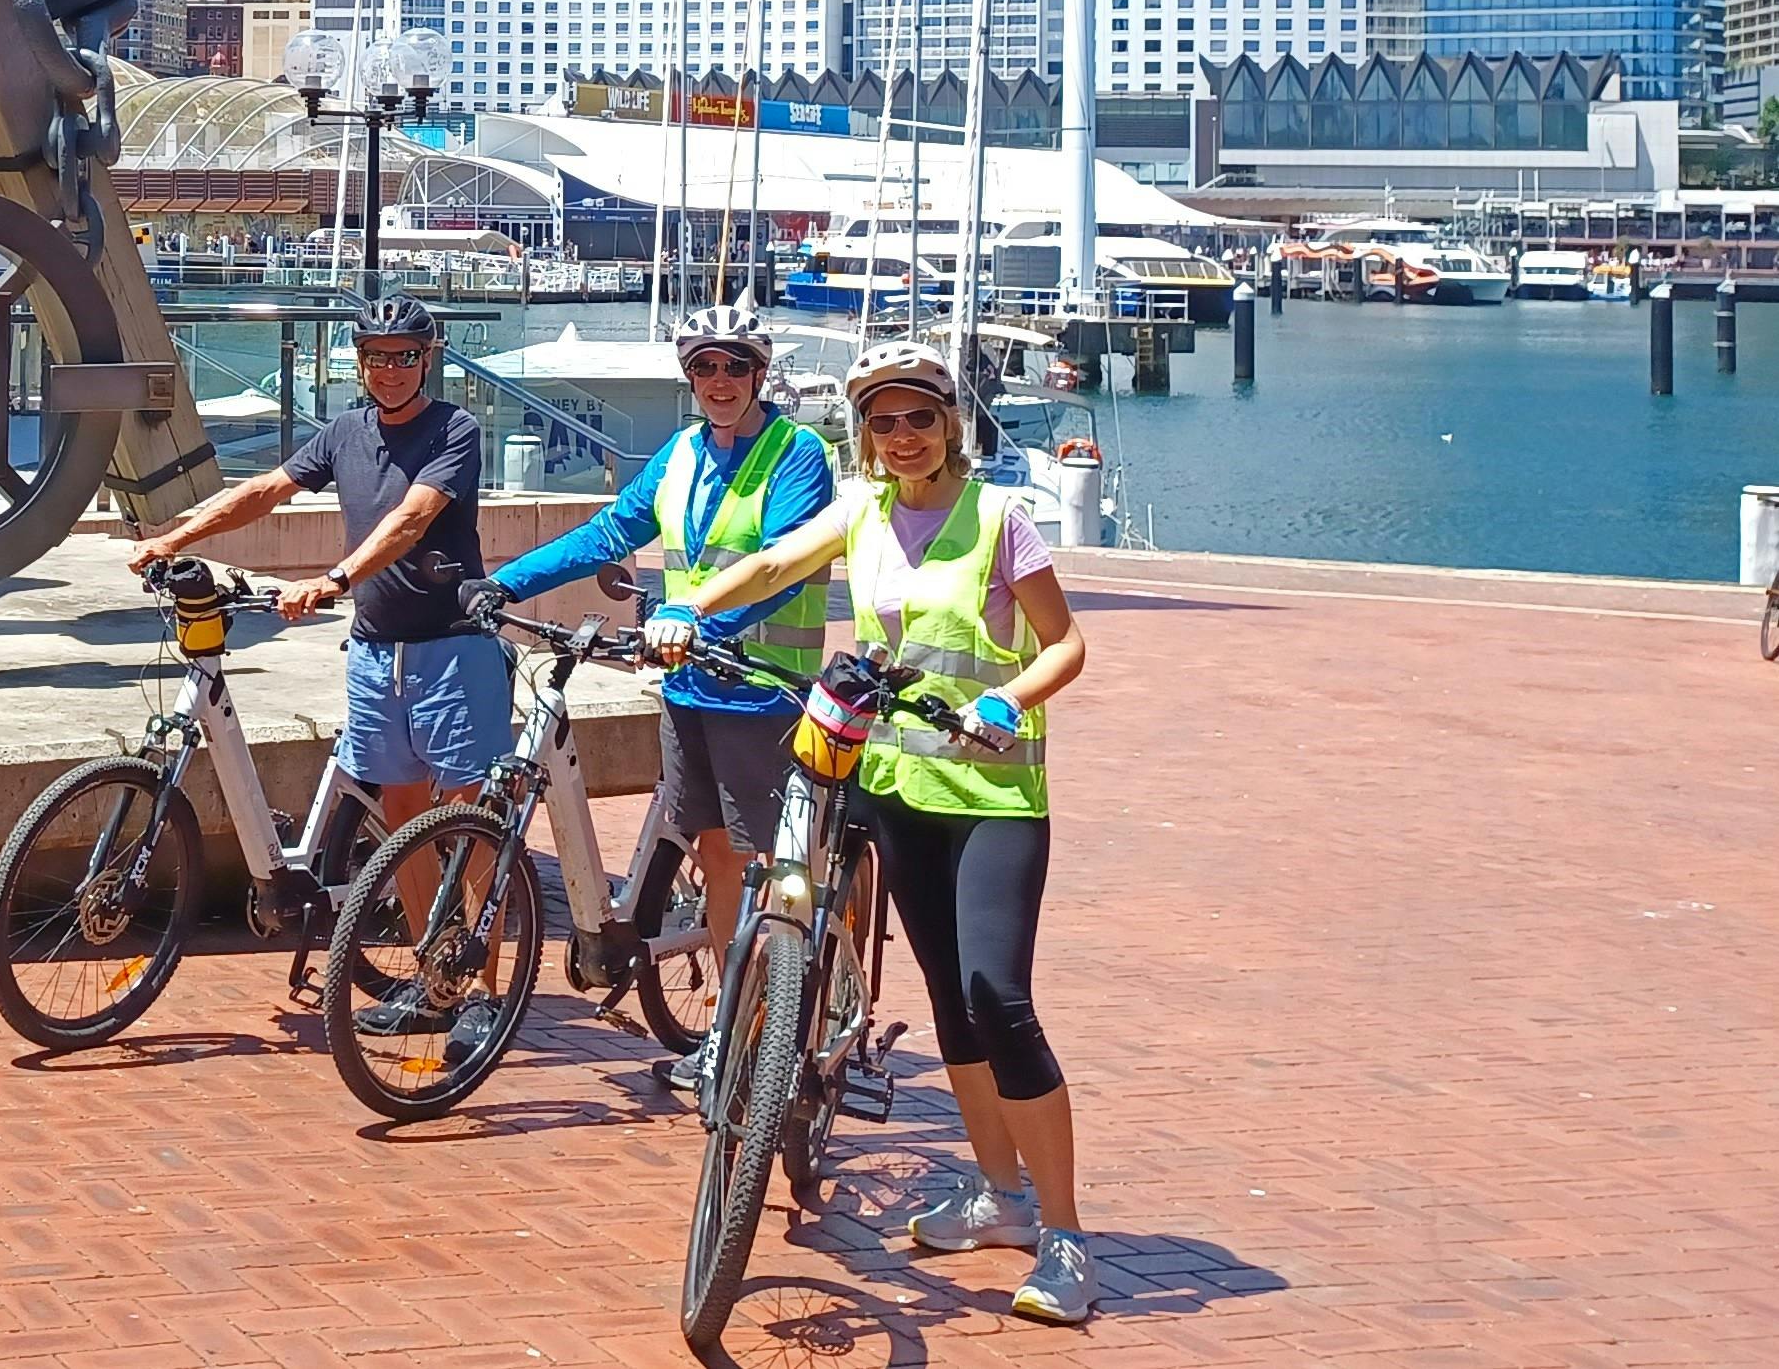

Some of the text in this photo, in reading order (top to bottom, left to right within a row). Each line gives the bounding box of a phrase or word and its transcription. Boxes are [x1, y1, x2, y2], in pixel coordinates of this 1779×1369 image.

[607, 87, 650, 112] WILD LIFE
[147, 373, 174, 401] E
[586, 399, 606, 412] BY
[129, 845, 152, 880] XCM
[475, 900, 498, 938] XCM
[702, 1026, 722, 1081] XCM
